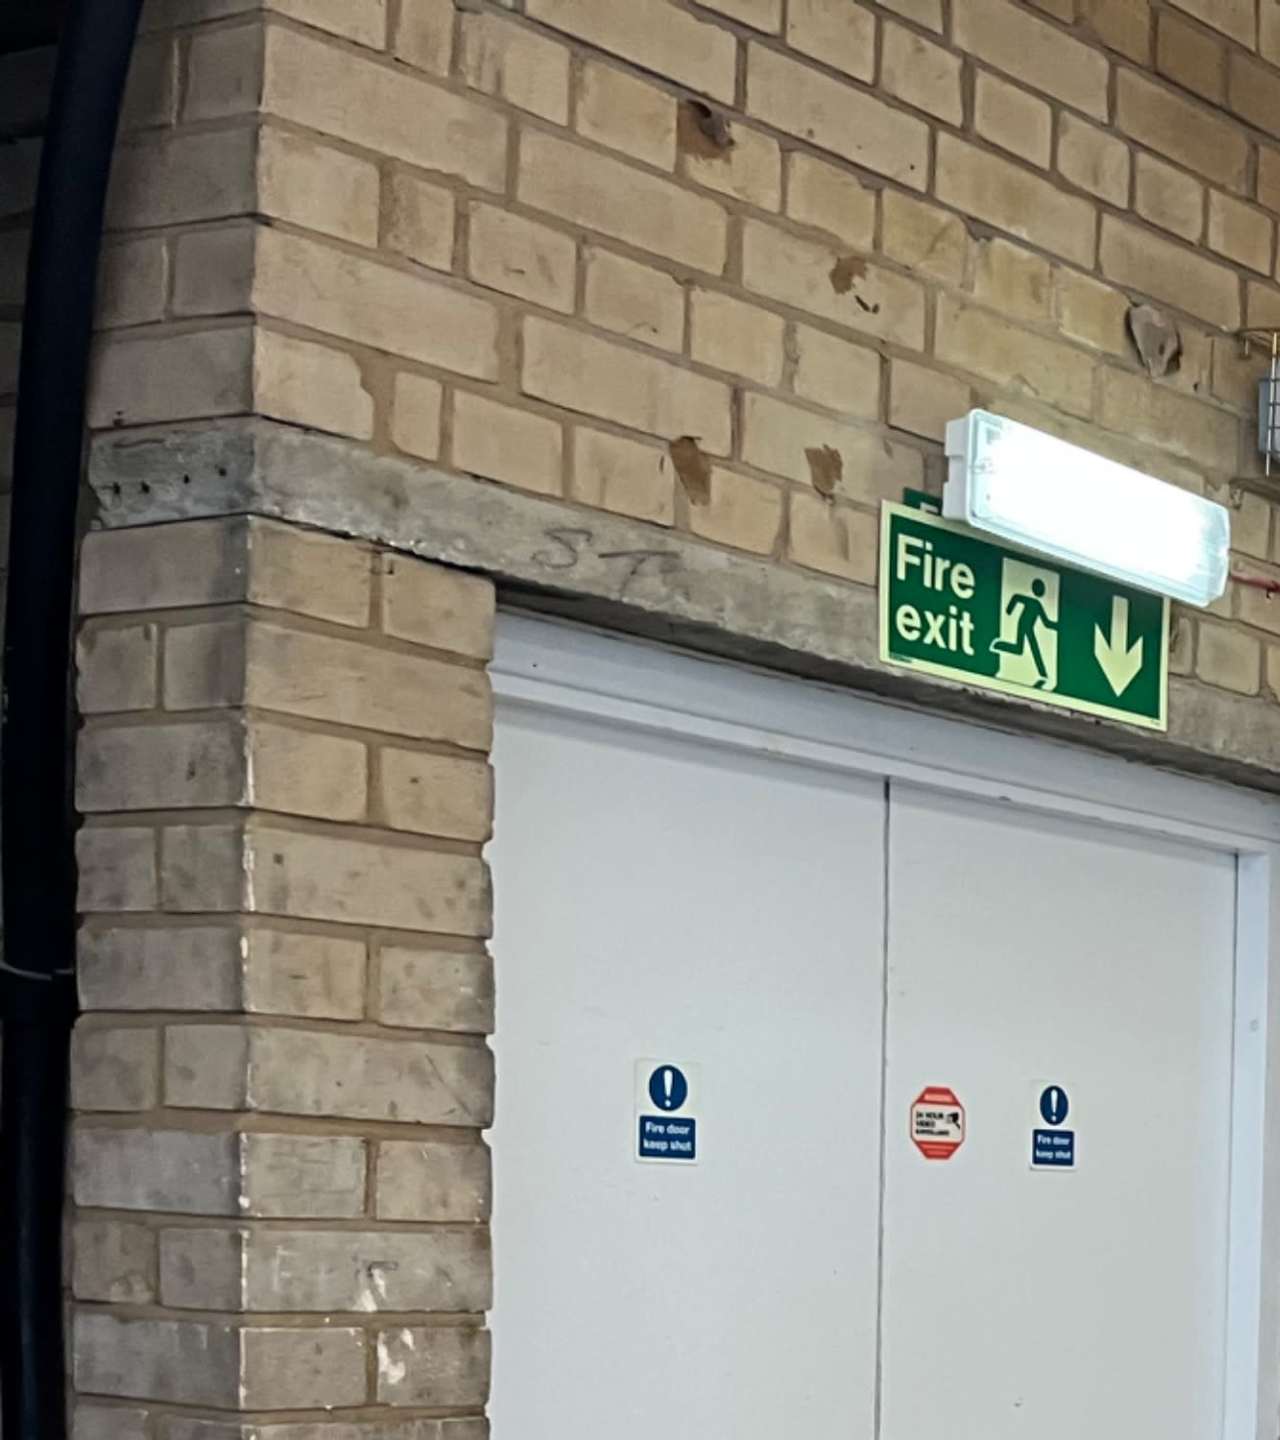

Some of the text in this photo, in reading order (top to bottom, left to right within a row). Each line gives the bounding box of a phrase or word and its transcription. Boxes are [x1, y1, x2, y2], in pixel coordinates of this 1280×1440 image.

[896, 533, 976, 599] Fire
[895, 604, 975, 656] exit
[645, 1120, 665, 1134] Fire
